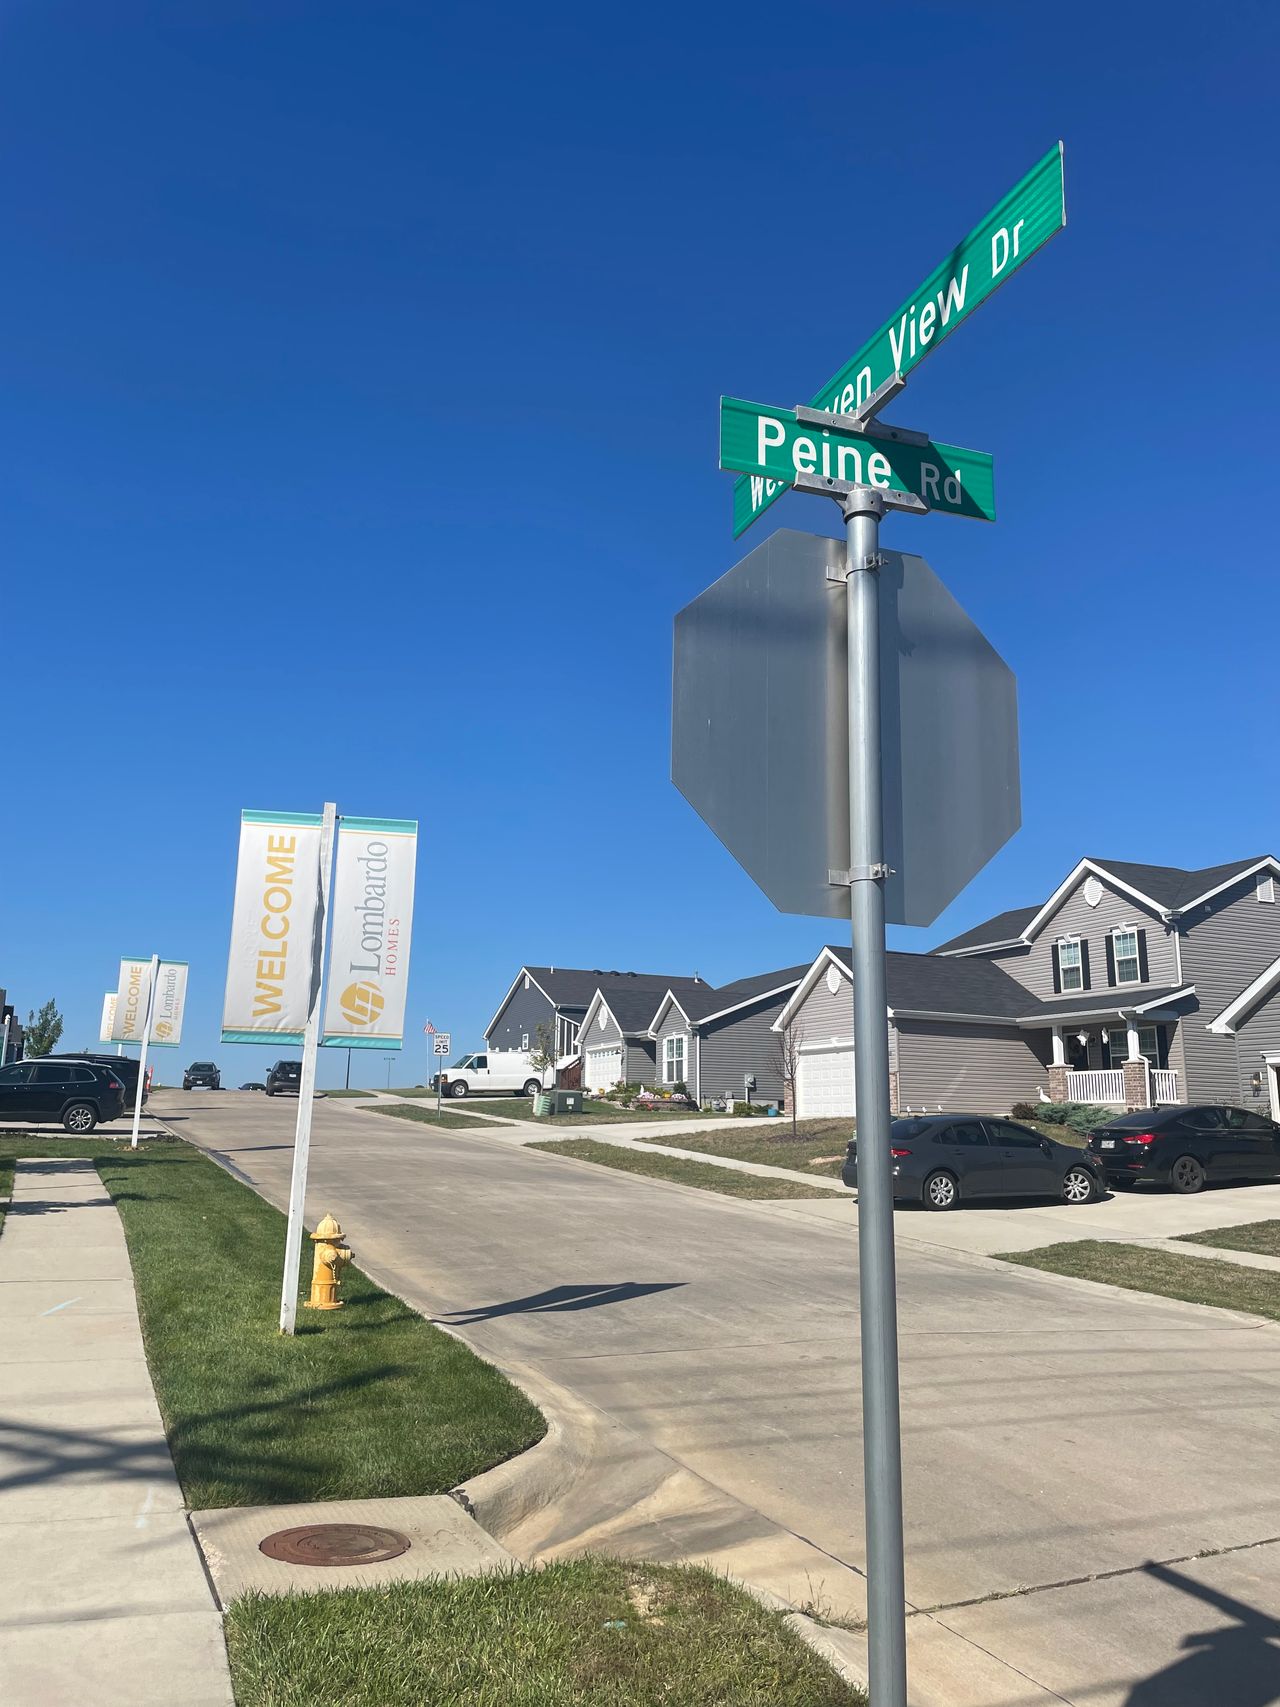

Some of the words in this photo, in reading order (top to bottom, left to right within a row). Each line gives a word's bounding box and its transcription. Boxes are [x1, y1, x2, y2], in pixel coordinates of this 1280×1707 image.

[888, 264, 969, 372] View
[991, 218, 1025, 279] Dr
[757, 415, 892, 490] Peine
[920, 462, 963, 505] Rd
[252, 834, 297, 1018] WELCOME
[349, 841, 389, 976] Lombardo
[385, 918, 400, 977] HOMES
[122, 966, 143, 1034] WELCOME
[160, 968, 177, 1020] Lombardo
[434, 1044, 448, 1054] 25
